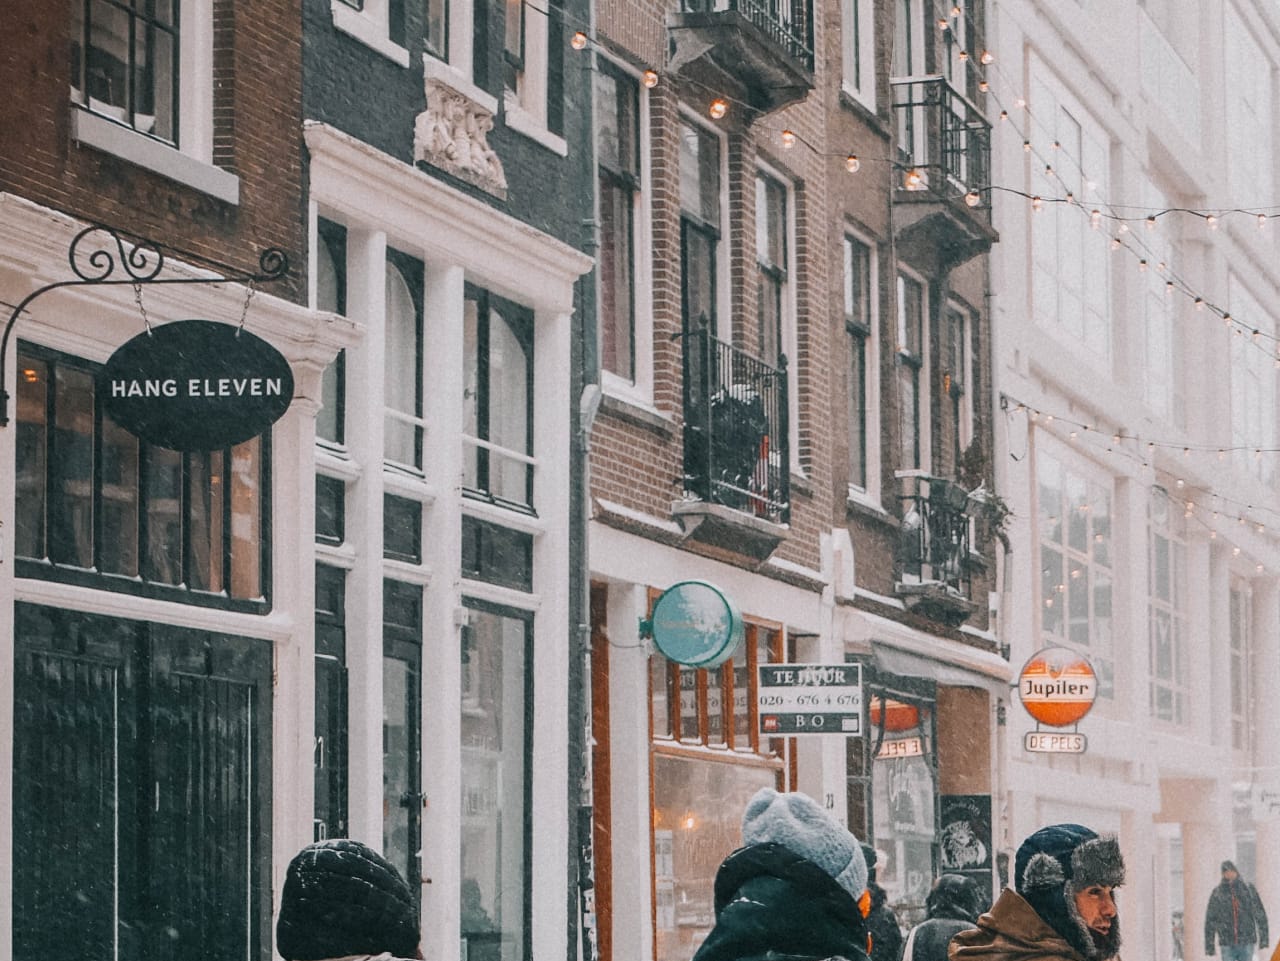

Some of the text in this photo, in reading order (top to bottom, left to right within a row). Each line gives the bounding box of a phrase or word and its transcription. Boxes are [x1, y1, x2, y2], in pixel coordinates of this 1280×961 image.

[112, 378, 282, 398] HANG ELEVEN
[773, 670, 794, 684] TE
[1025, 680, 1089, 698] Jupiler
[760, 695, 784, 706] 020
[796, 695, 819, 706] 676
[836, 695, 860, 705] 676
[1030, 735, 1082, 750] DE PELS
